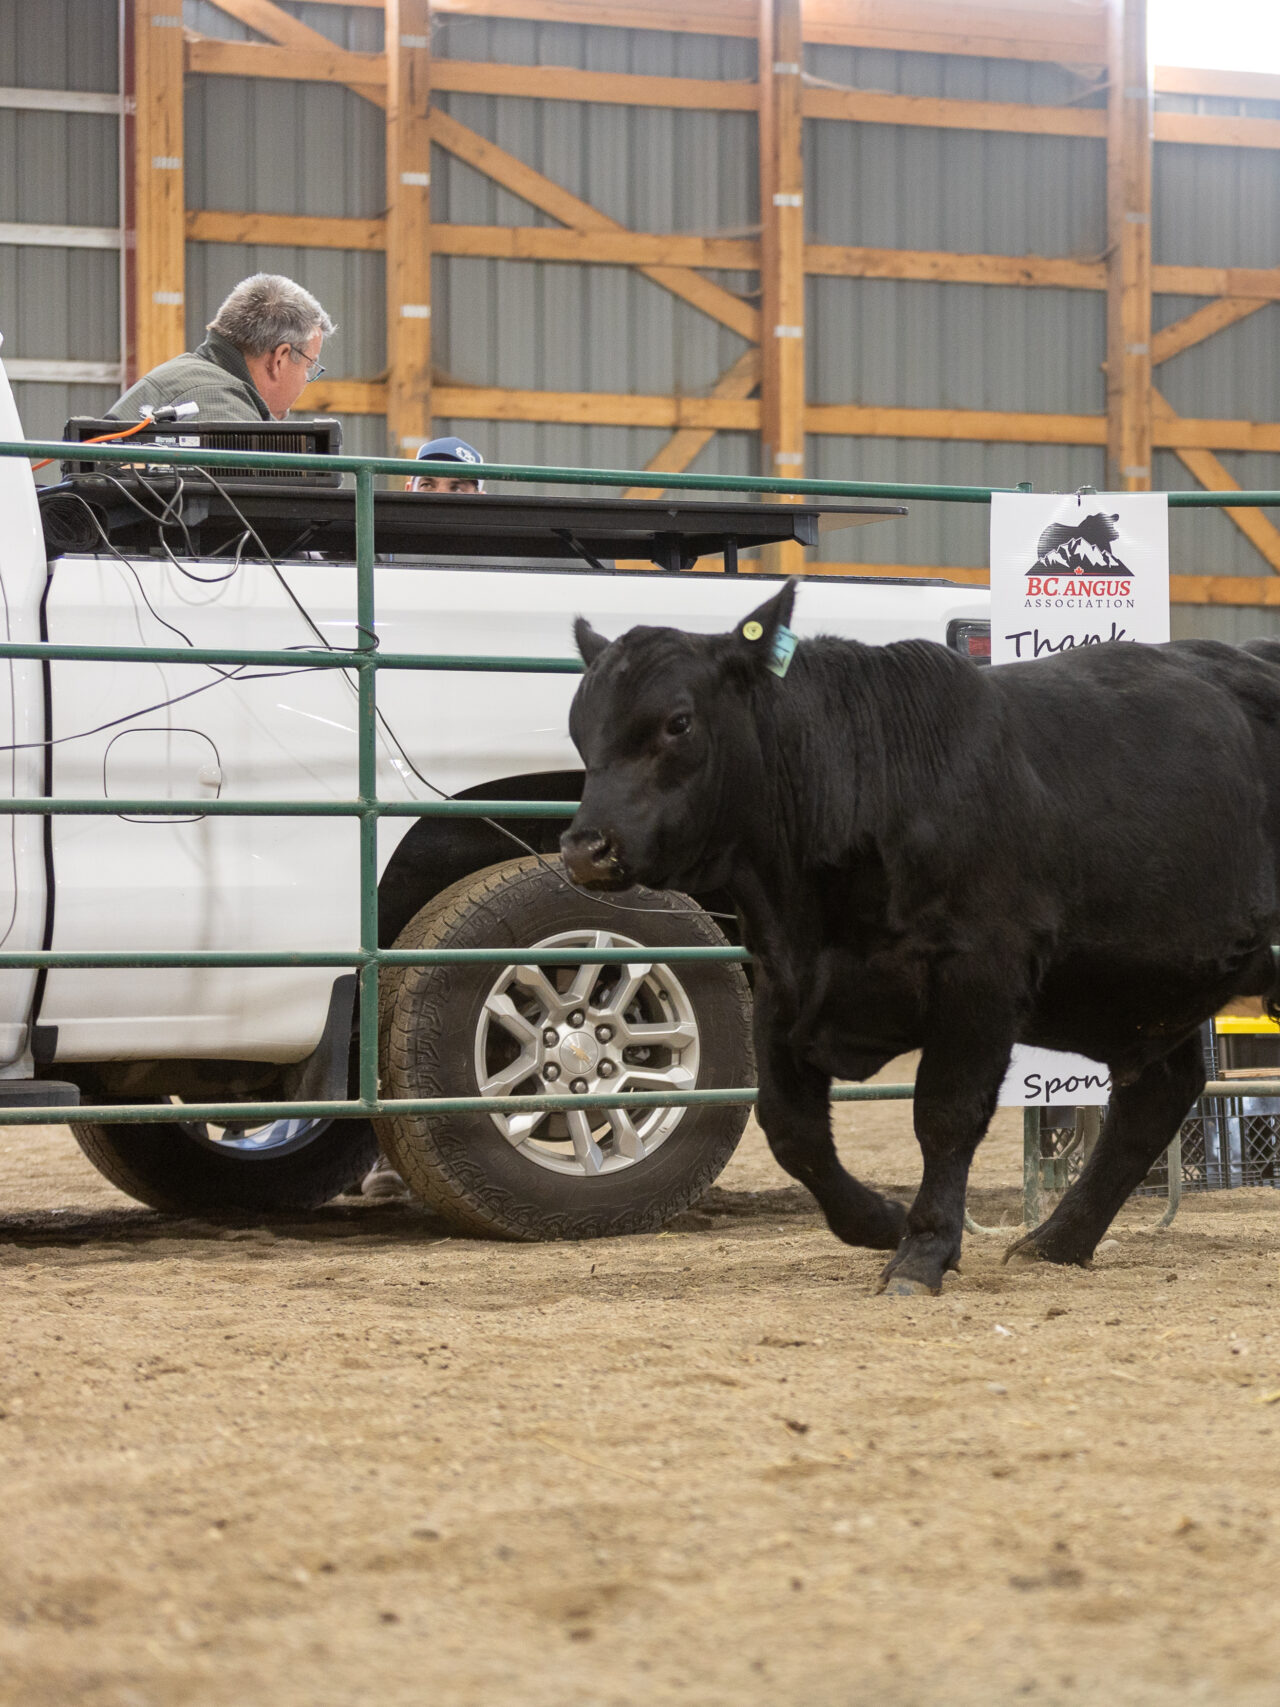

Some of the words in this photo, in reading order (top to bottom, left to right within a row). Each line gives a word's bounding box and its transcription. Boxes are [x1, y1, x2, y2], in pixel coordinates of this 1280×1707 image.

[1063, 580, 1131, 598] ANGUS
[1024, 599, 1135, 609] ASSOCIATION
[1024, 1073, 1112, 1103] Spon
